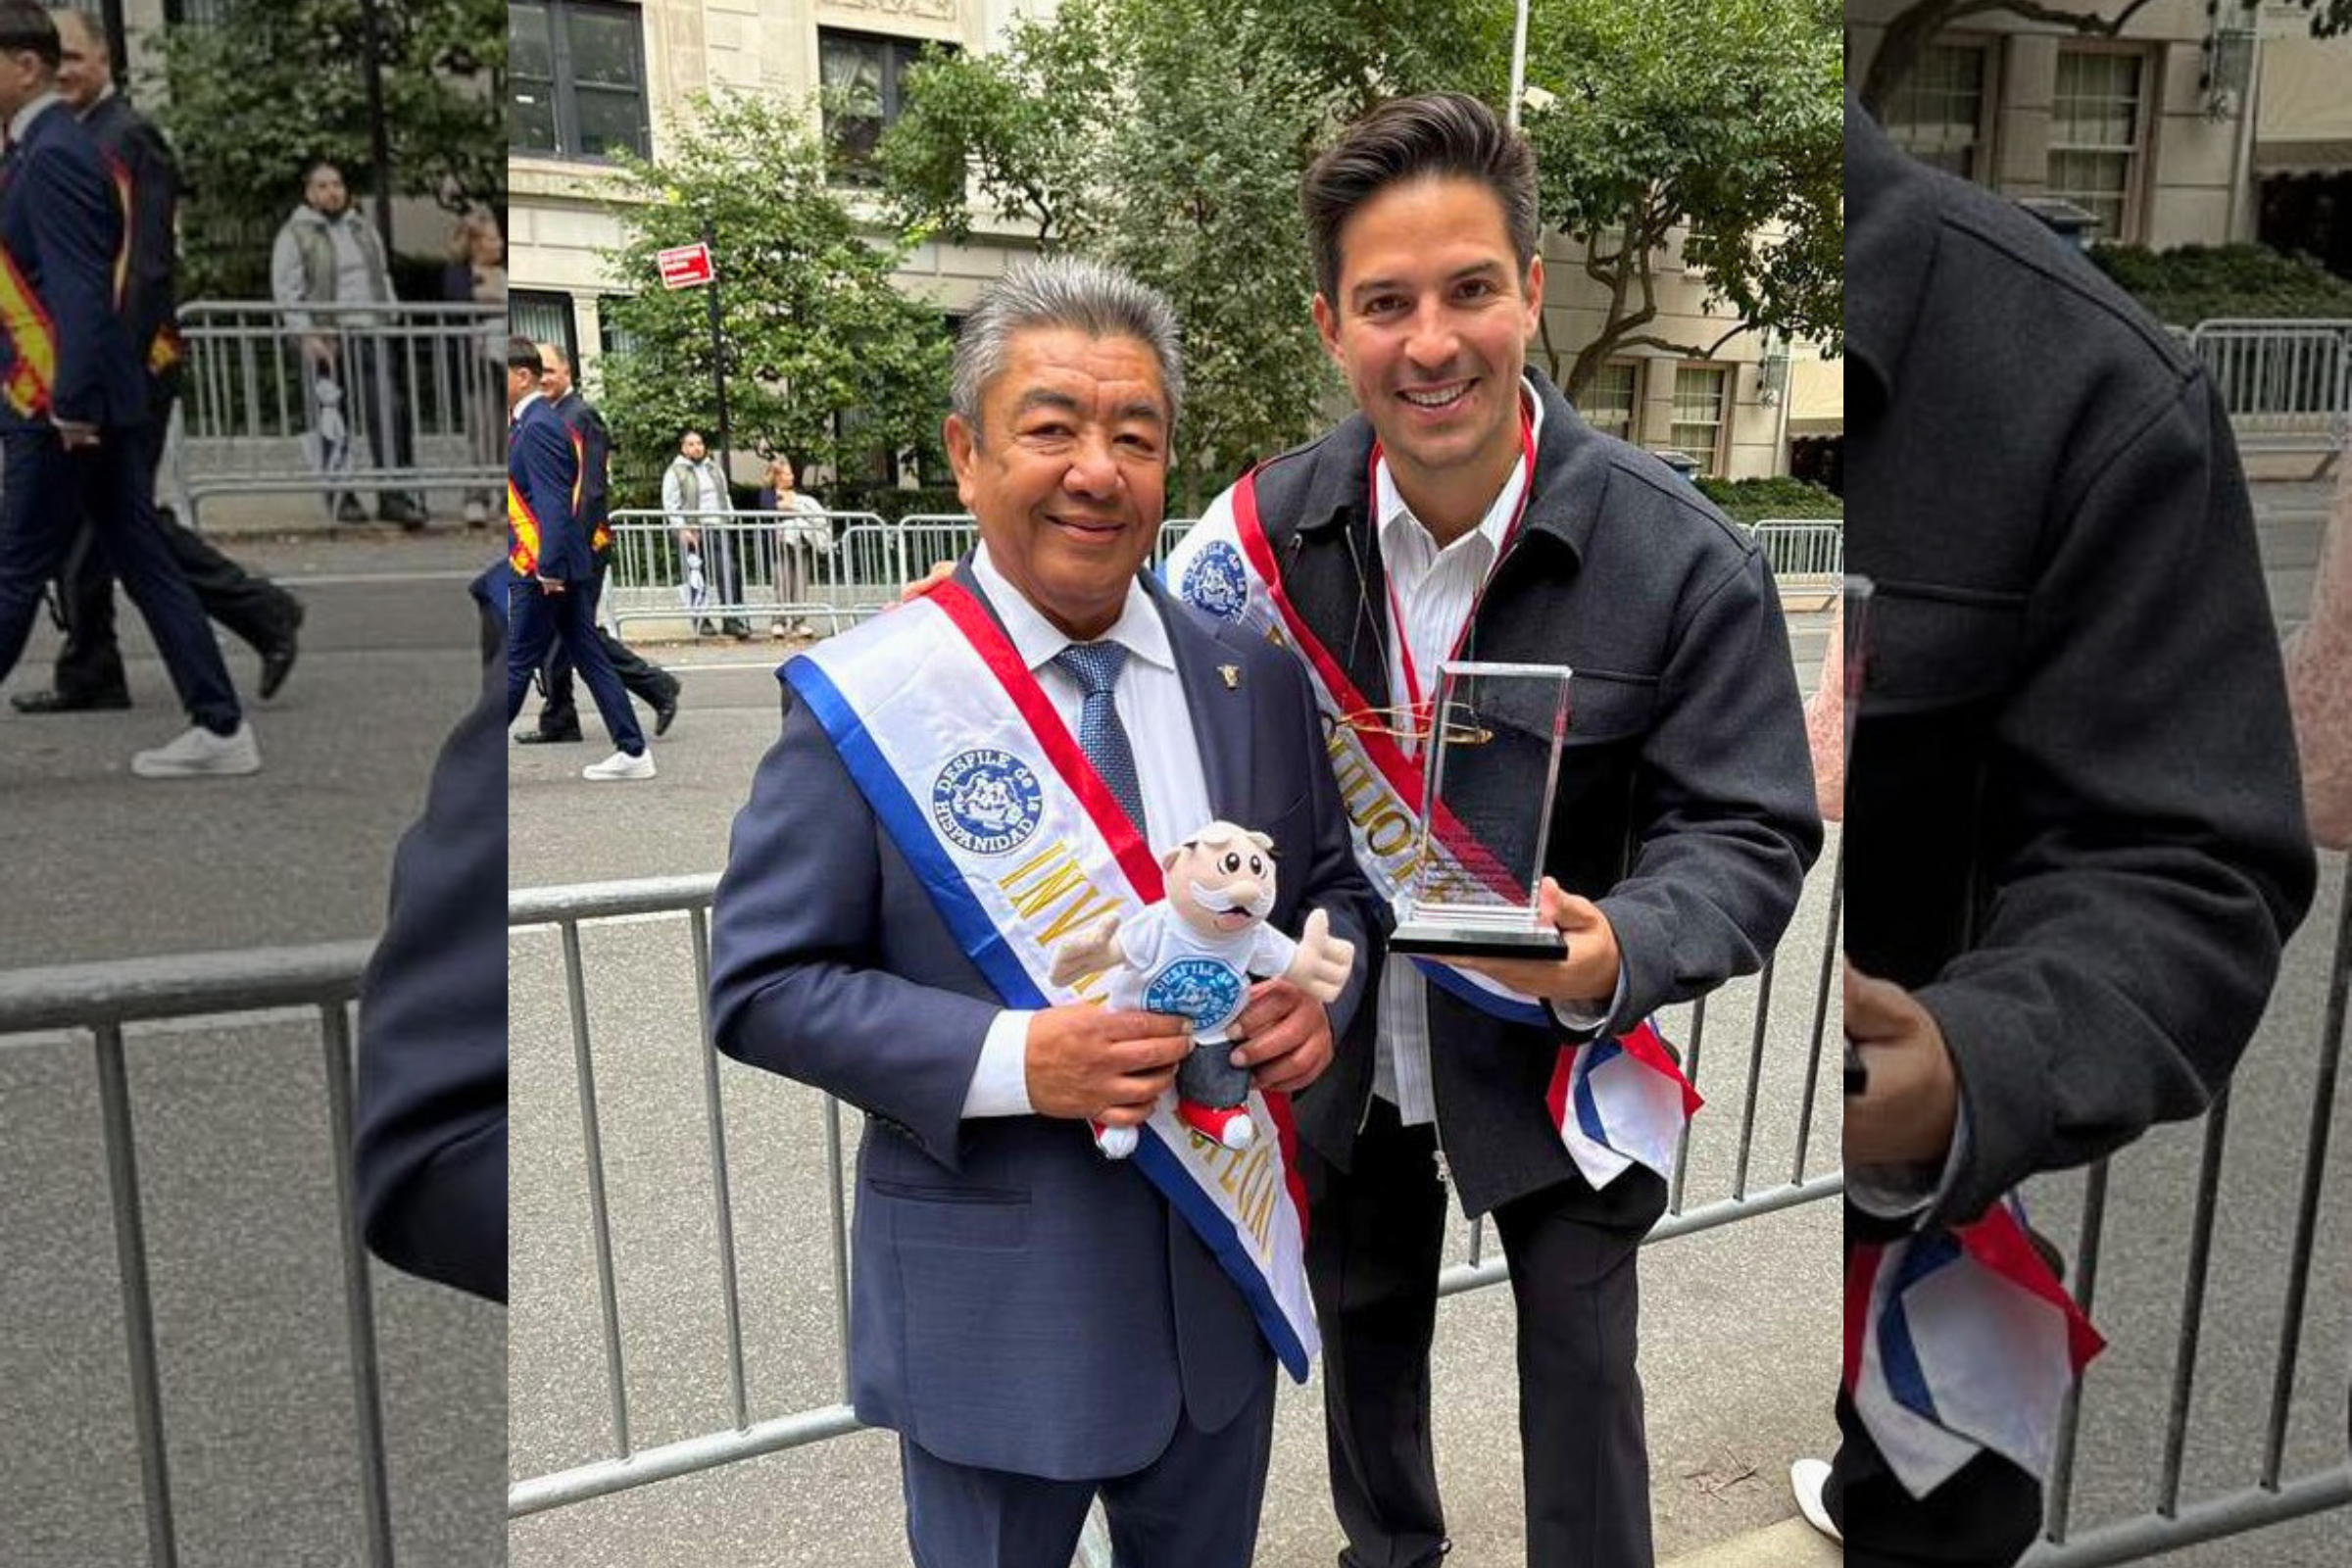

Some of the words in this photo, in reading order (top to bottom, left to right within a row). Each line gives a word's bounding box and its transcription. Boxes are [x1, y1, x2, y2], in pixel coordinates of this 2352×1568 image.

[937, 751, 1011, 794] DESFILE
[1014, 767, 1035, 788] de
[1027, 795, 1043, 811] la
[934, 801, 1035, 853] HISPANIDAD
